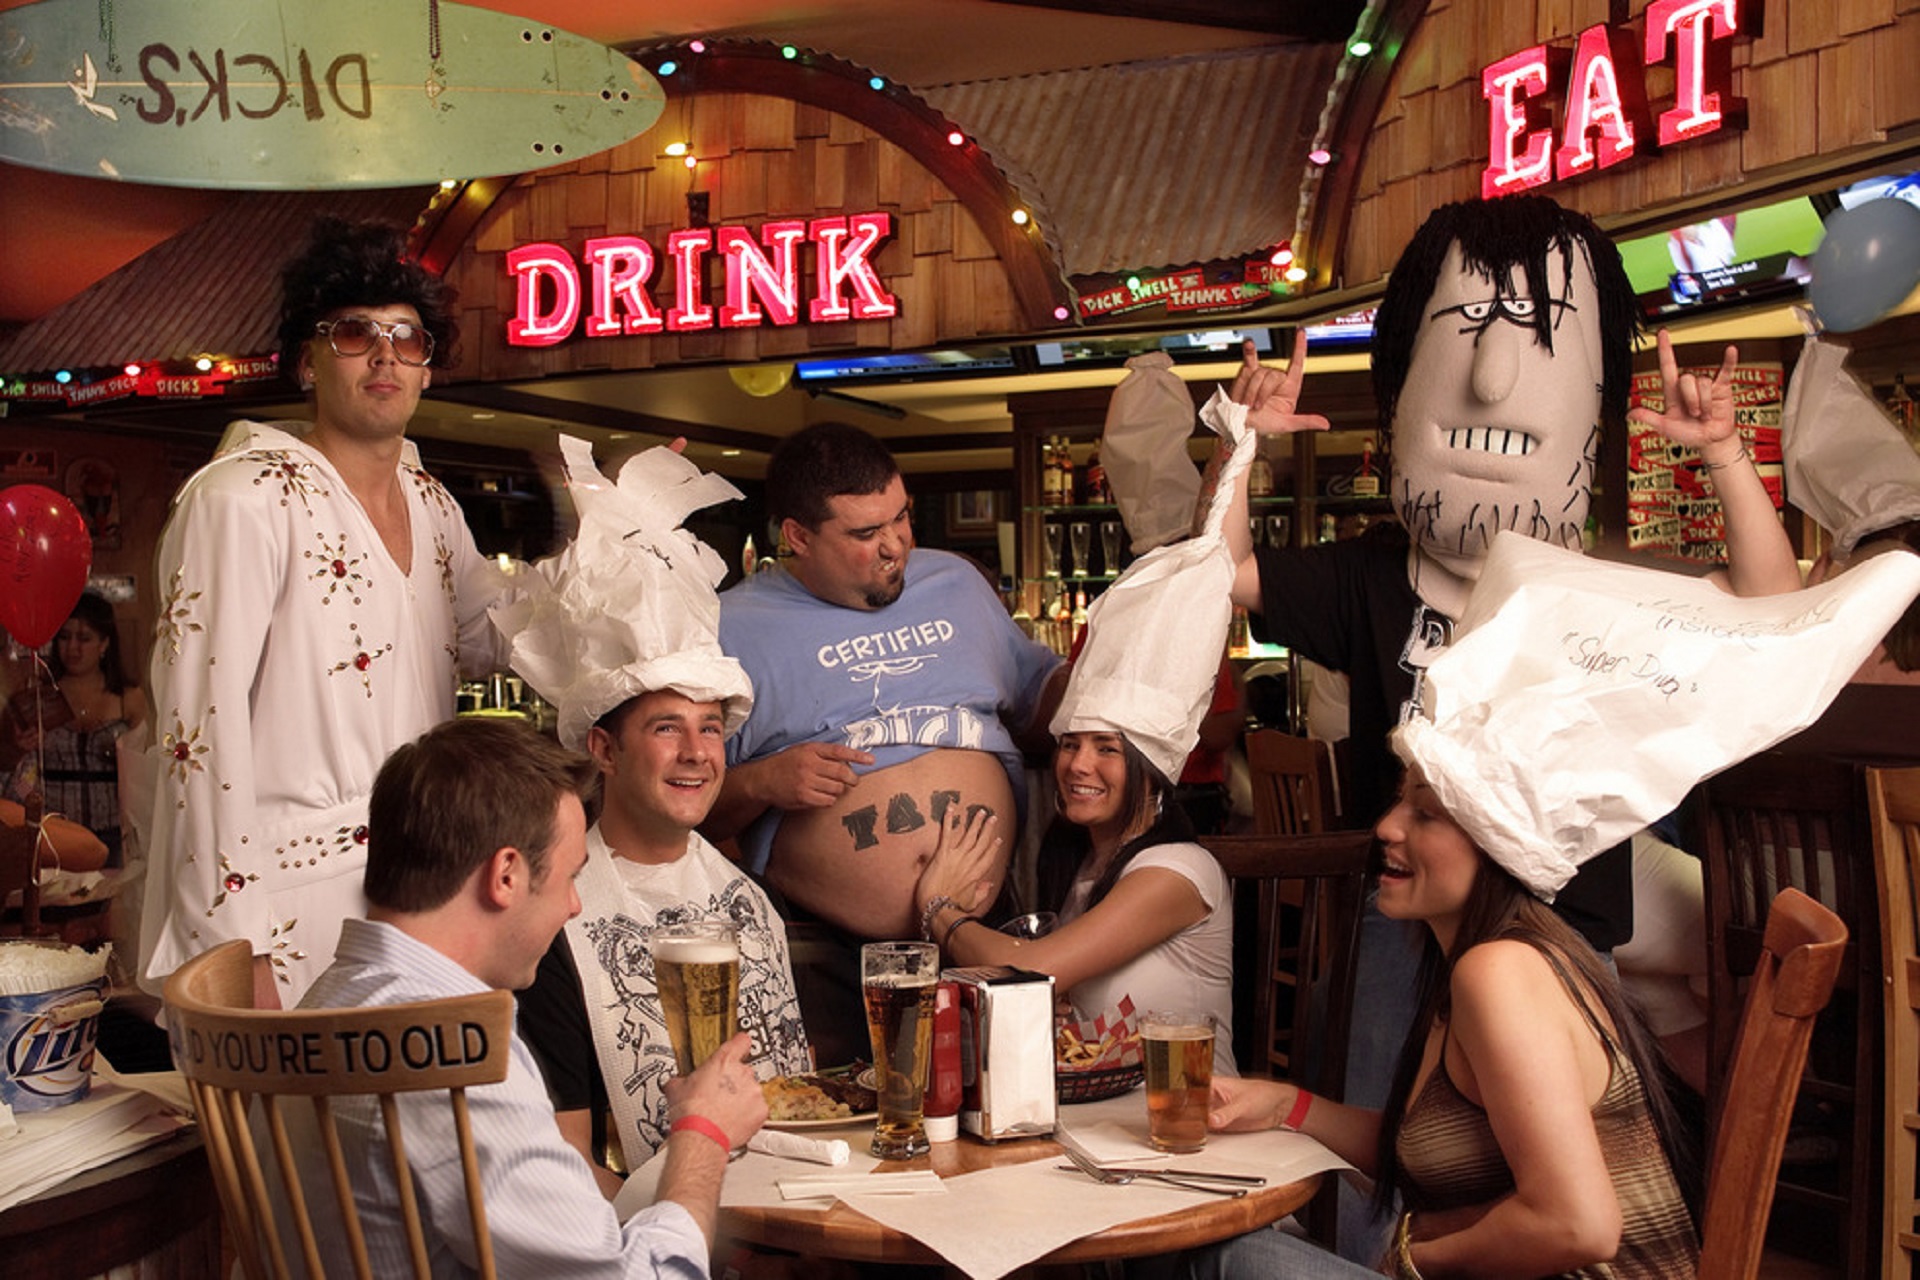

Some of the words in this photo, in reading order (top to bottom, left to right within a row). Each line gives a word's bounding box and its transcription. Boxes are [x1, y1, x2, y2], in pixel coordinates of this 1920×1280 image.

[137, 43, 372, 126] DICK'S
[1481, 0, 1738, 199] EAT
[507, 212, 899, 347] DRINK
[1083, 291, 1123, 312] DICK
[1170, 288, 1227, 305] THINK
[157, 378, 200, 394] DICK'S
[817, 619, 954, 668] CERTIFIED
[208, 1030, 326, 1075] YOU'RE
[334, 1029, 392, 1074] TO
[400, 1021, 489, 1070] OLD
